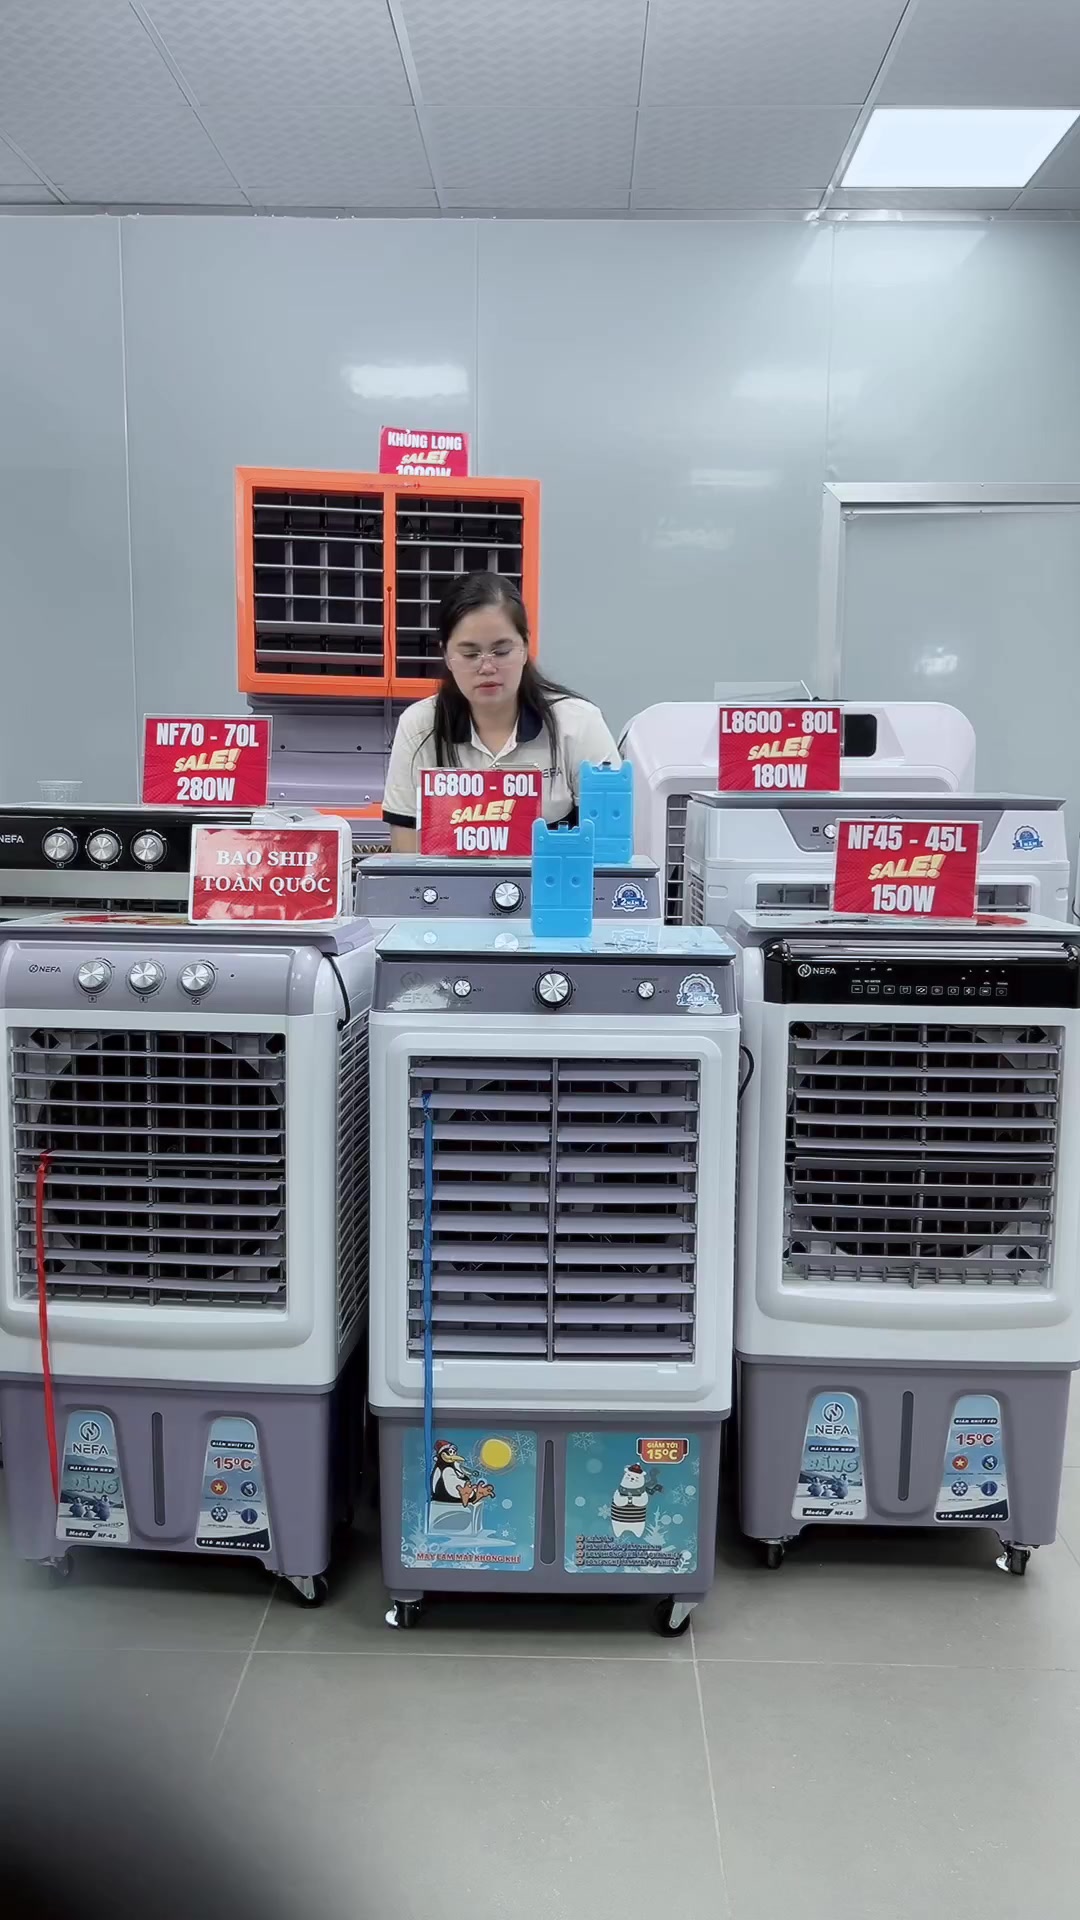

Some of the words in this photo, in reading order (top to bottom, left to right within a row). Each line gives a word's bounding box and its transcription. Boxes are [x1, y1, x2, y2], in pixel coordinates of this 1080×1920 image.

[388, 429, 428, 449] KHỦNG
[431, 435, 463, 450] LONG
[401, 450, 450, 465] SALE!
[721, 710, 783, 734] L8600
[801, 710, 838, 734] 80L
[156, 722, 205, 747] NF70
[224, 723, 260, 748] 70L
[173, 747, 242, 773] SALE!
[747, 735, 814, 761] SALE!
[424, 773, 485, 797] L6800
[503, 773, 539, 797] 60L
[751, 763, 808, 789] 180W
[176, 776, 236, 802] 280W
[449, 798, 517, 825] SALE!
[453, 826, 509, 851] 160W
[847, 824, 903, 851] NF45
[924, 826, 968, 852] 45L
[216, 850, 262, 866] BAO
[267, 851, 318, 867] SHIP
[867, 853, 946, 880] SALE!
[201, 872, 263, 892] TOÀN
[269, 872, 331, 896] QUỐC
[871, 883, 936, 913] 150W
[812, 967, 837, 975] NEFA
[814, 1424, 851, 1435] NEFA
[72, 1443, 109, 1455] NEFA
